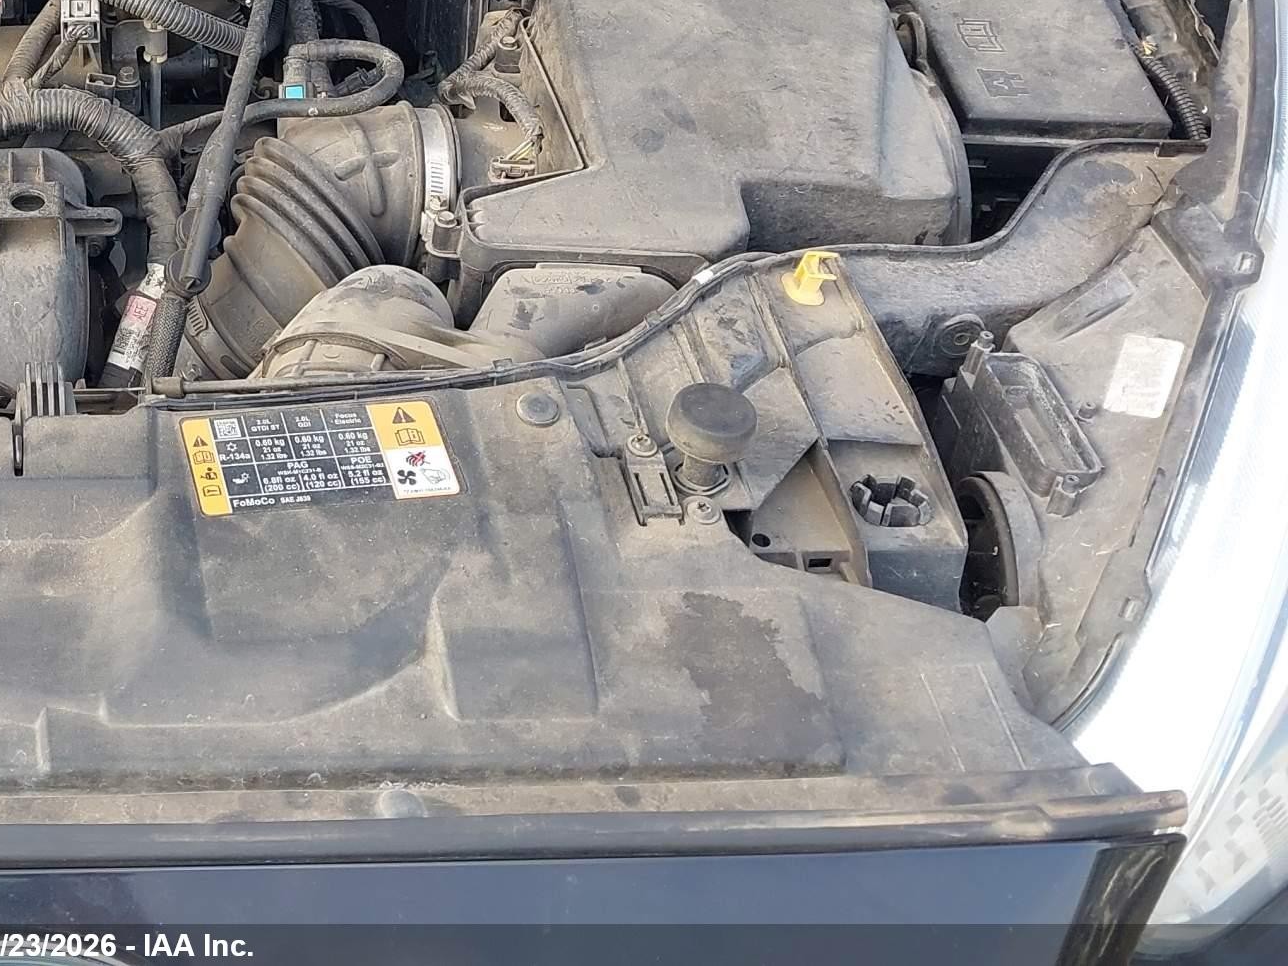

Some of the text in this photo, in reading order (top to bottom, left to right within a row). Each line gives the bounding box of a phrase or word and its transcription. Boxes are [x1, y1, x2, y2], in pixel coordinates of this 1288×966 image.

[334, 417, 362, 425] Electric
[313, 434, 324, 445] kg
[356, 431, 368, 442] kg
[274, 437, 285, 447] kg
[219, 452, 251, 461] R-134a
[350, 456, 372, 464] POE
[286, 461, 309, 469] PAG
[303, 474, 316, 482] 4.0
[347, 469, 361, 478] 5.2
[370, 468, 383, 476] oz
[283, 475, 296, 483] oz
[305, 479, 341, 489] (120 cc)
[350, 475, 387, 485] (155 cc)
[264, 482, 300, 492] (200 cc)
[233, 497, 276, 507] FoMoCo
